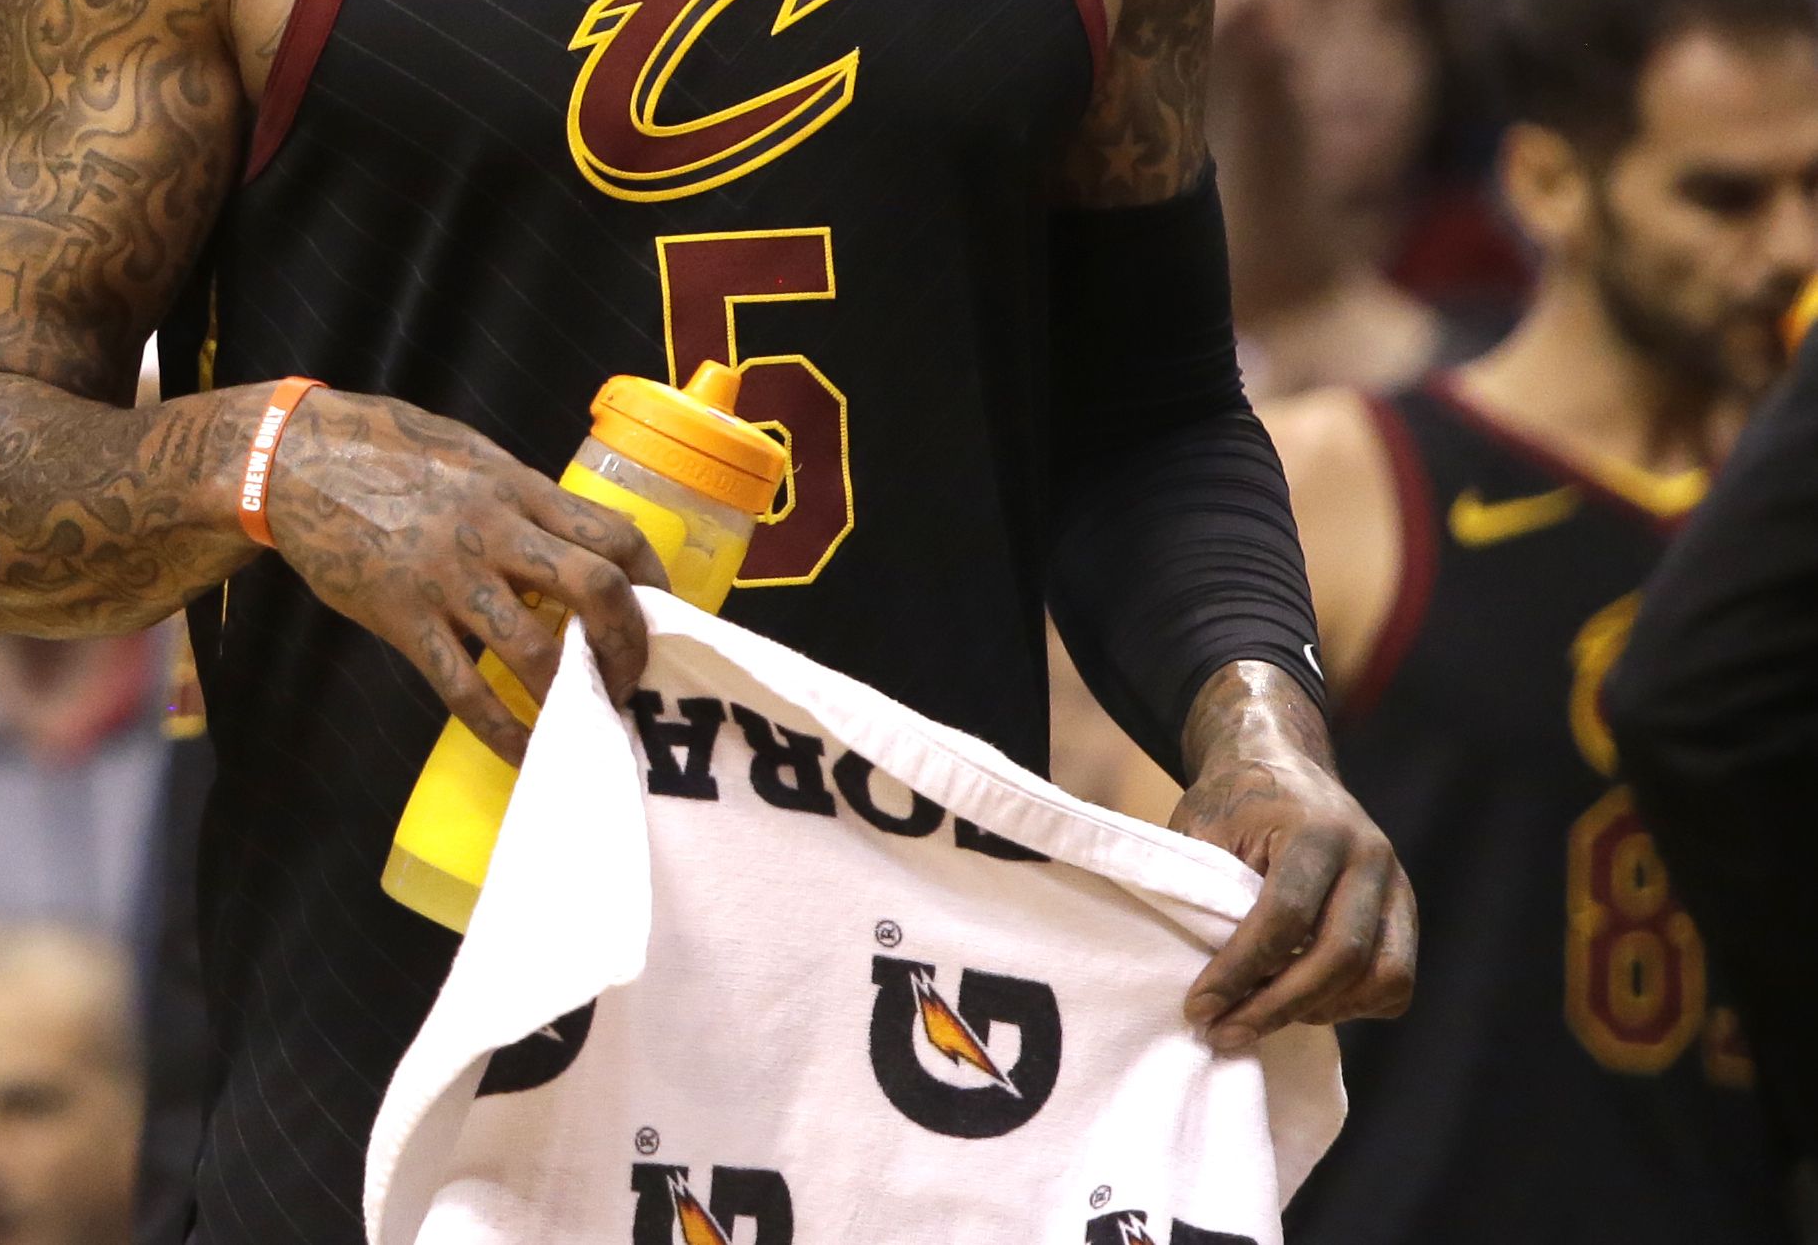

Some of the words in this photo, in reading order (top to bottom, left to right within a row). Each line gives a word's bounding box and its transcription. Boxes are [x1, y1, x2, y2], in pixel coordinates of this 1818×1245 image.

[242, 451, 269, 512] CREW
[255, 406, 286, 449] ONLY
[655, 226, 855, 586] 5
[1565, 783, 1756, 1090] 8
[869, 954, 1062, 1139] G
